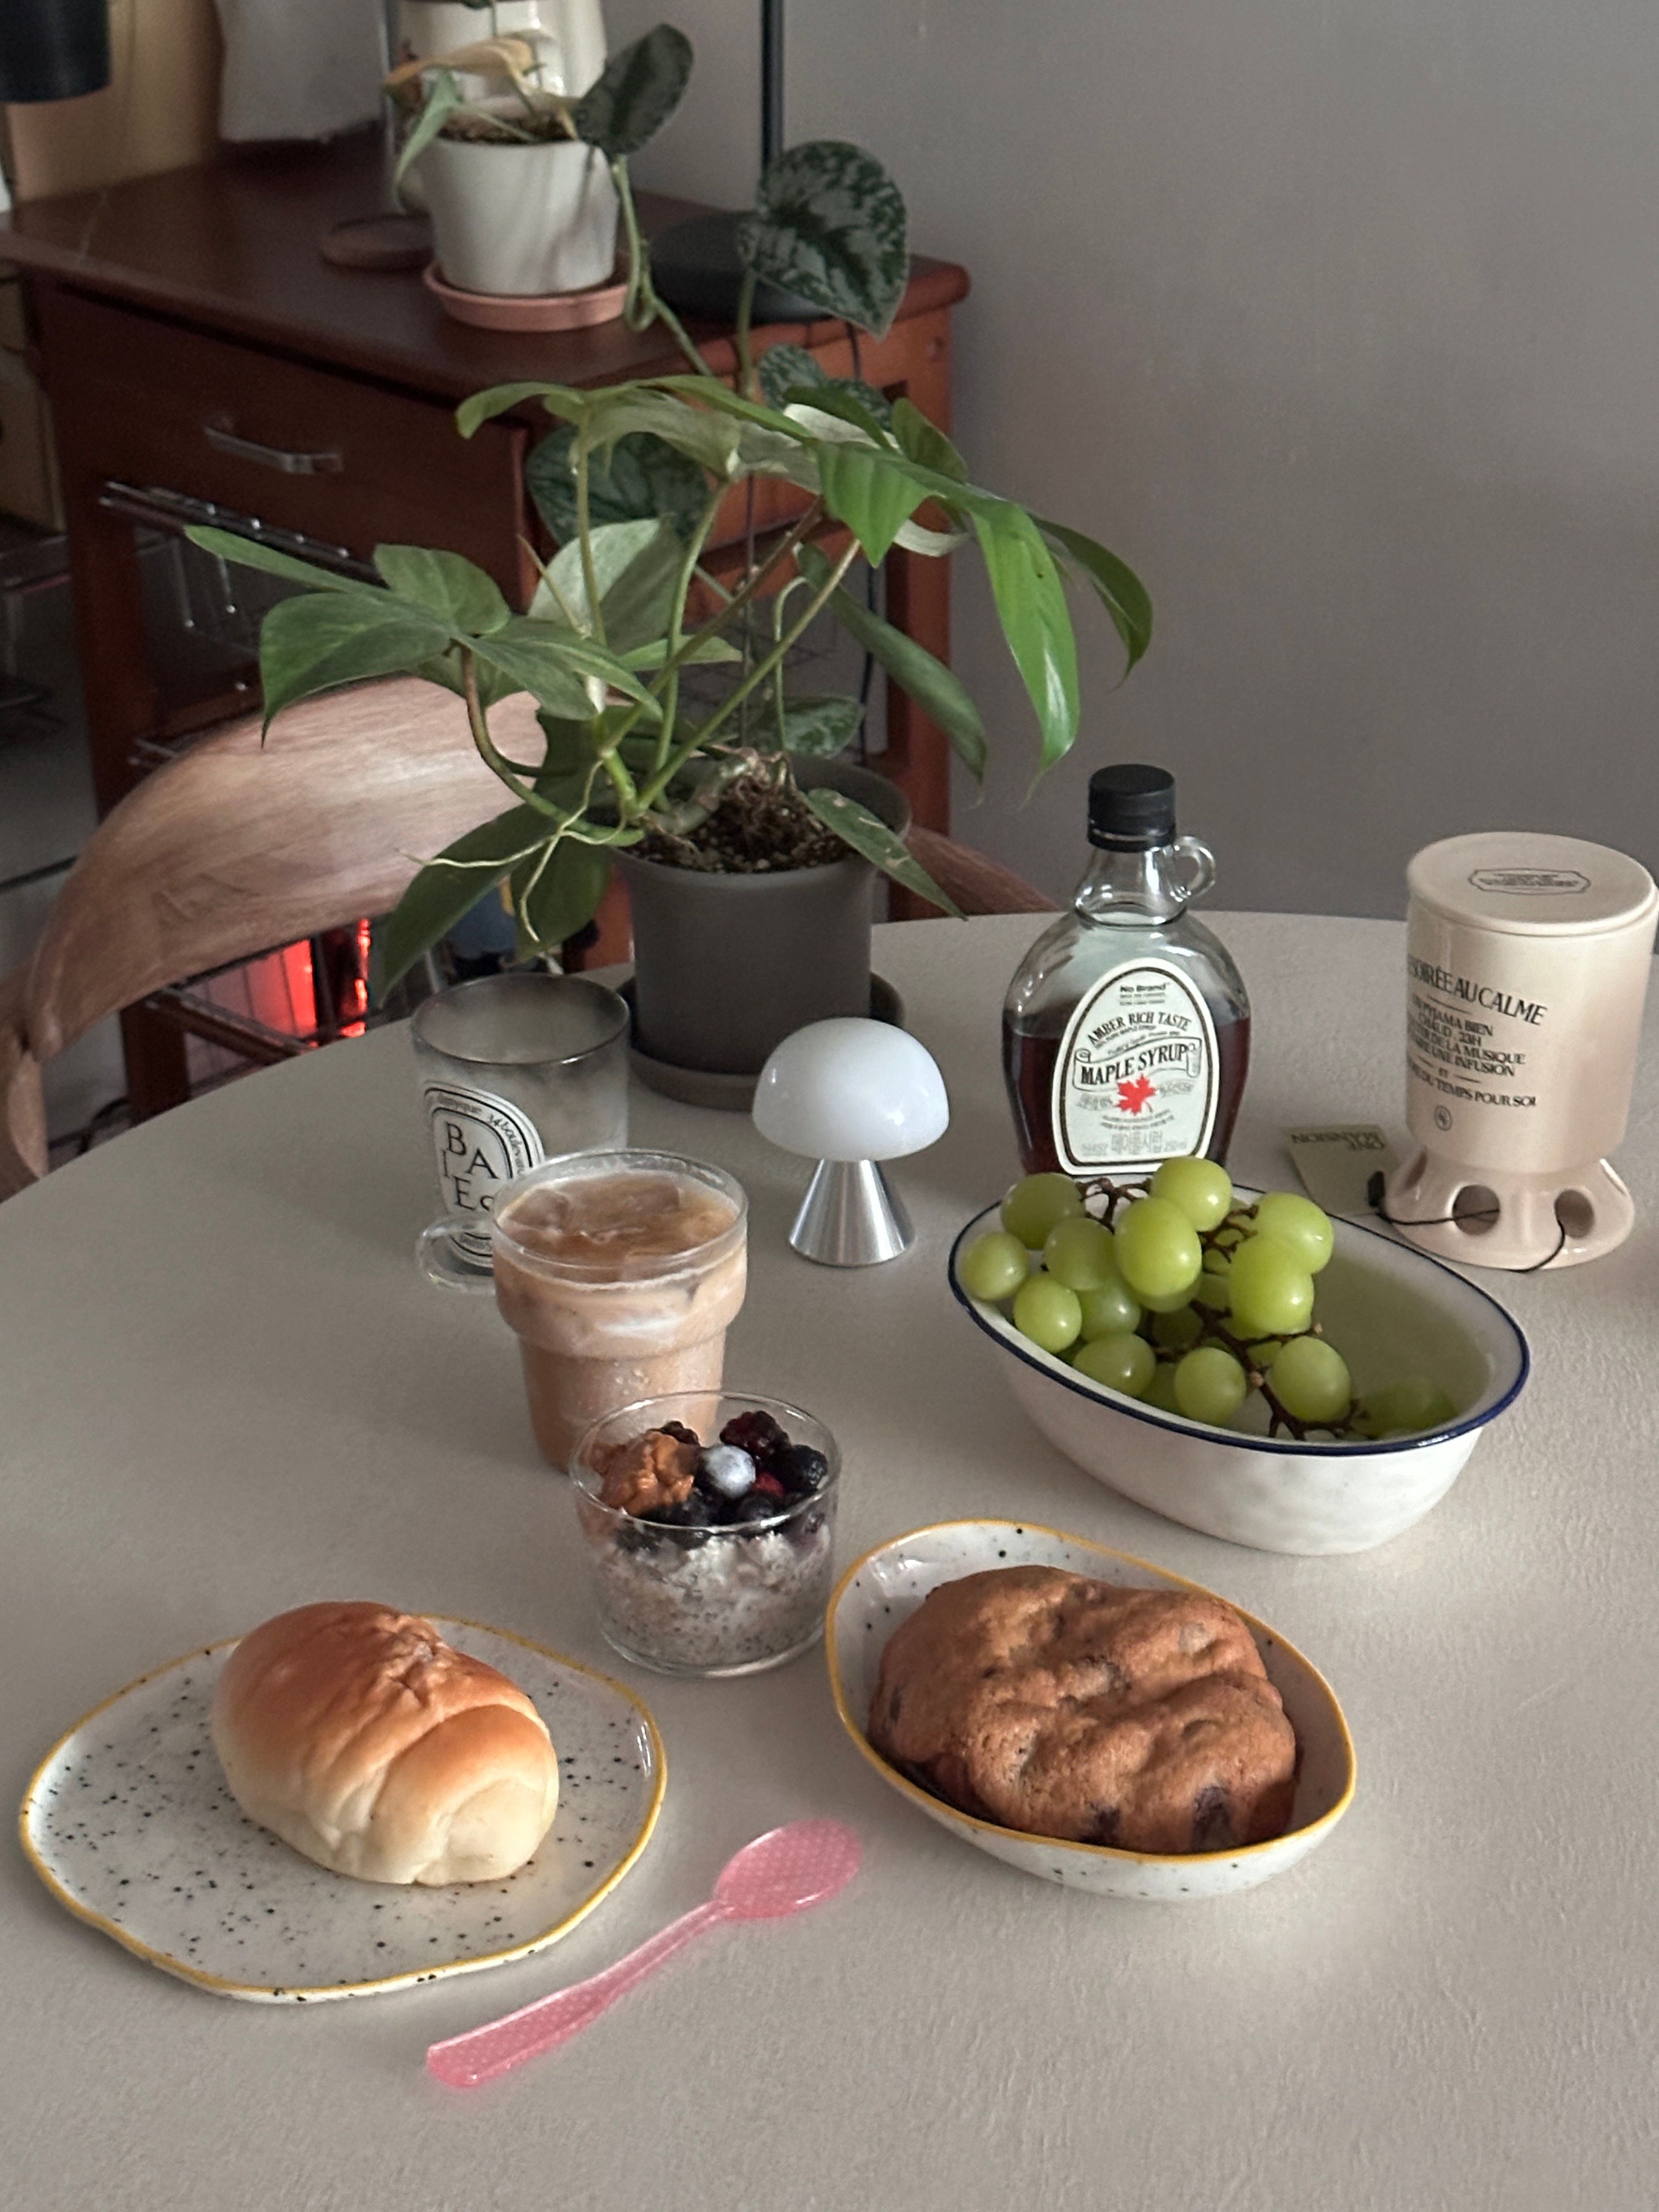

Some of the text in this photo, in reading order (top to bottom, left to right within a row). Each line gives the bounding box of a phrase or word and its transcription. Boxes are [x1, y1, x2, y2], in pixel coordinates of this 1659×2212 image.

[1120, 983, 1166, 993] No Brand
[1454, 978, 1477, 1002] AU
[1478, 986, 1548, 1025] CALME
[1088, 1016, 1126, 1044] AMBER
[1128, 1011, 1155, 1025] RICH
[1158, 1011, 1192, 1031] TASTE
[1464, 1019, 1493, 1036] BIEN
[1081, 1043, 1189, 1085] MAPLE SYRUP
[1454, 1055, 1515, 1077] INFUSION
[1463, 1045, 1526, 1065] MUSIQUE
[1435, 1077, 1473, 1100] TEMPS
[1474, 1090, 1511, 1107] POUR
[1513, 1095, 1536, 1108] SOI
